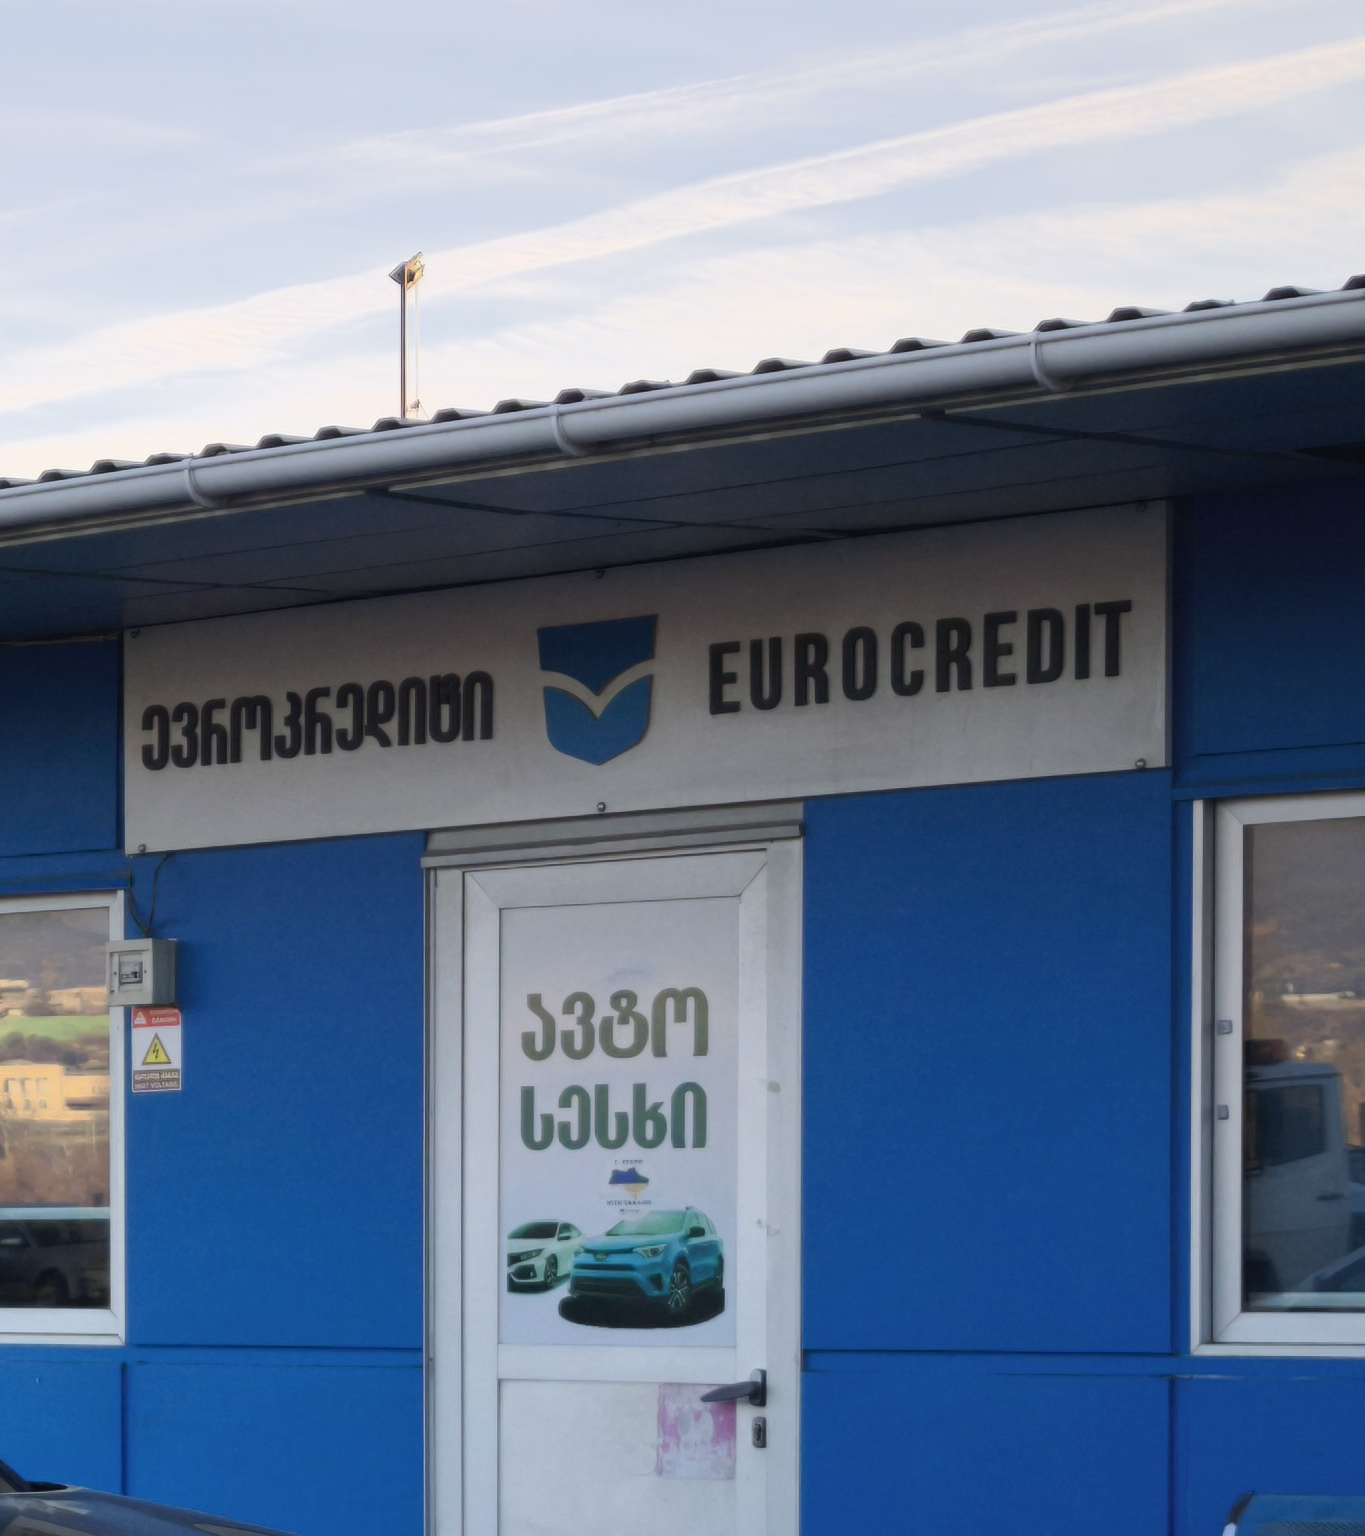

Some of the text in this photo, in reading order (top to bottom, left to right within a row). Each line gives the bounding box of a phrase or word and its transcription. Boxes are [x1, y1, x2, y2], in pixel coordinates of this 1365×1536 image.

[708, 599, 1132, 716] EUROCREDIT
[141, 670, 494, 771] ევროკრედიტი
[520, 986, 710, 1062] ავტო
[519, 1081, 709, 1151] სესხი
